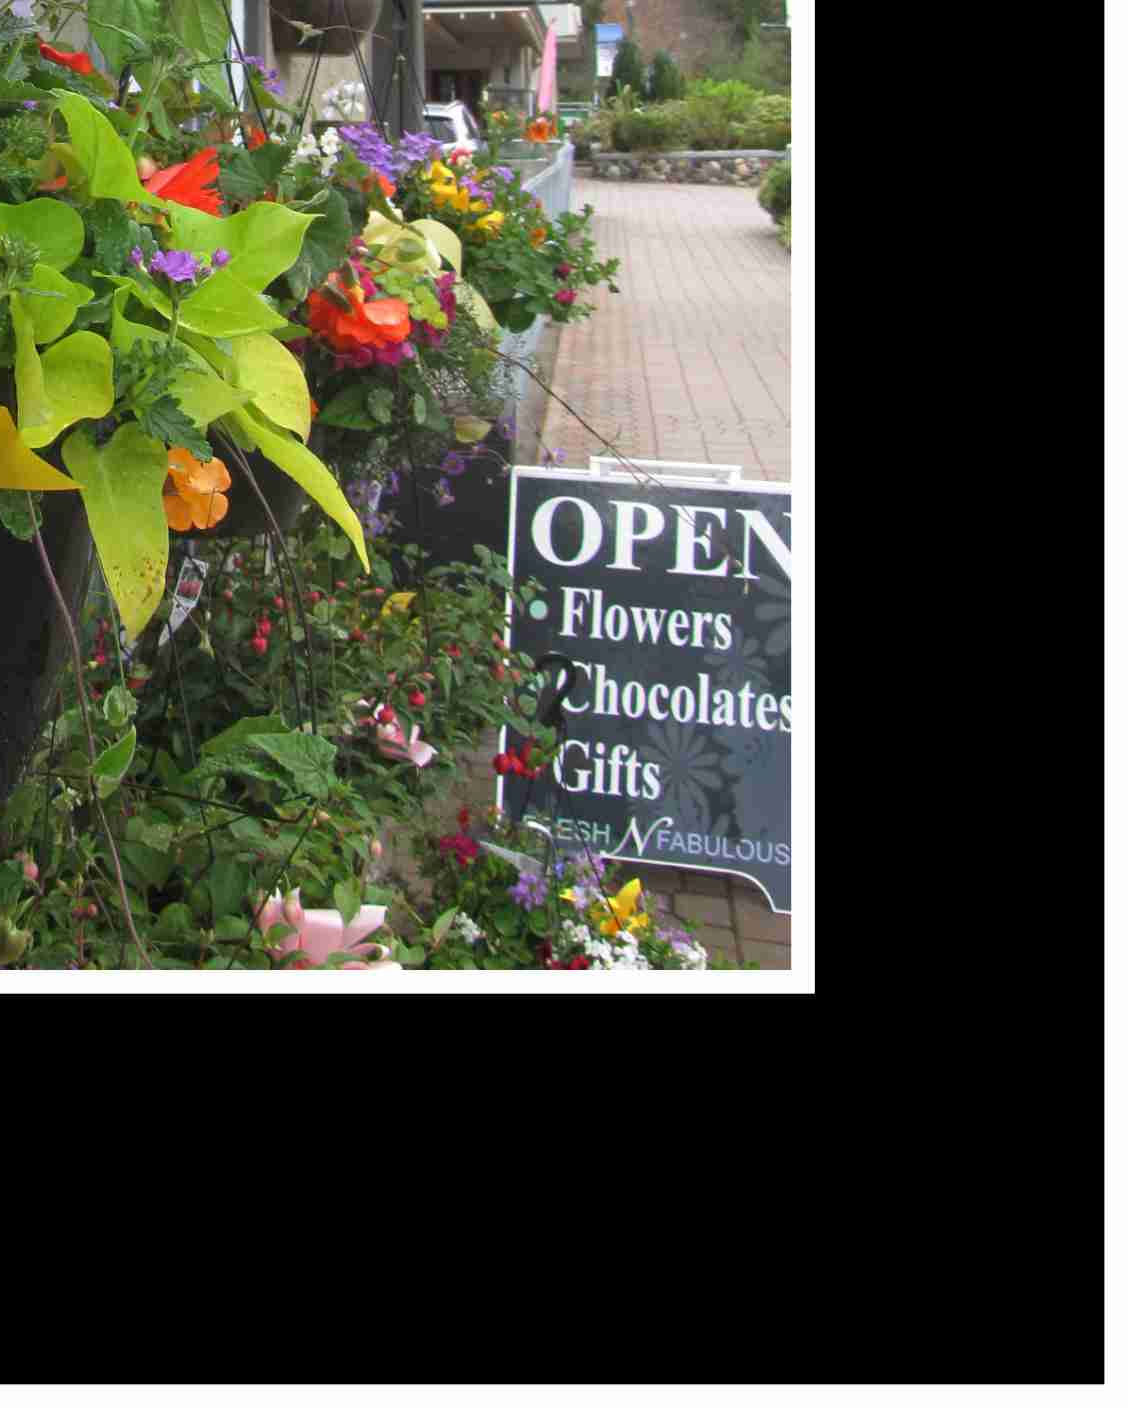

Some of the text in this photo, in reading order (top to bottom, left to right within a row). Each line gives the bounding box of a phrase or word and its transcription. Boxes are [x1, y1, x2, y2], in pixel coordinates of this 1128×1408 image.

[531, 495, 792, 580] OPEN
[559, 585, 733, 651] Flowers
[555, 660, 792, 734] Chocolates
[552, 739, 662, 800] Gifts
[656, 829, 791, 866] FABULOUS
